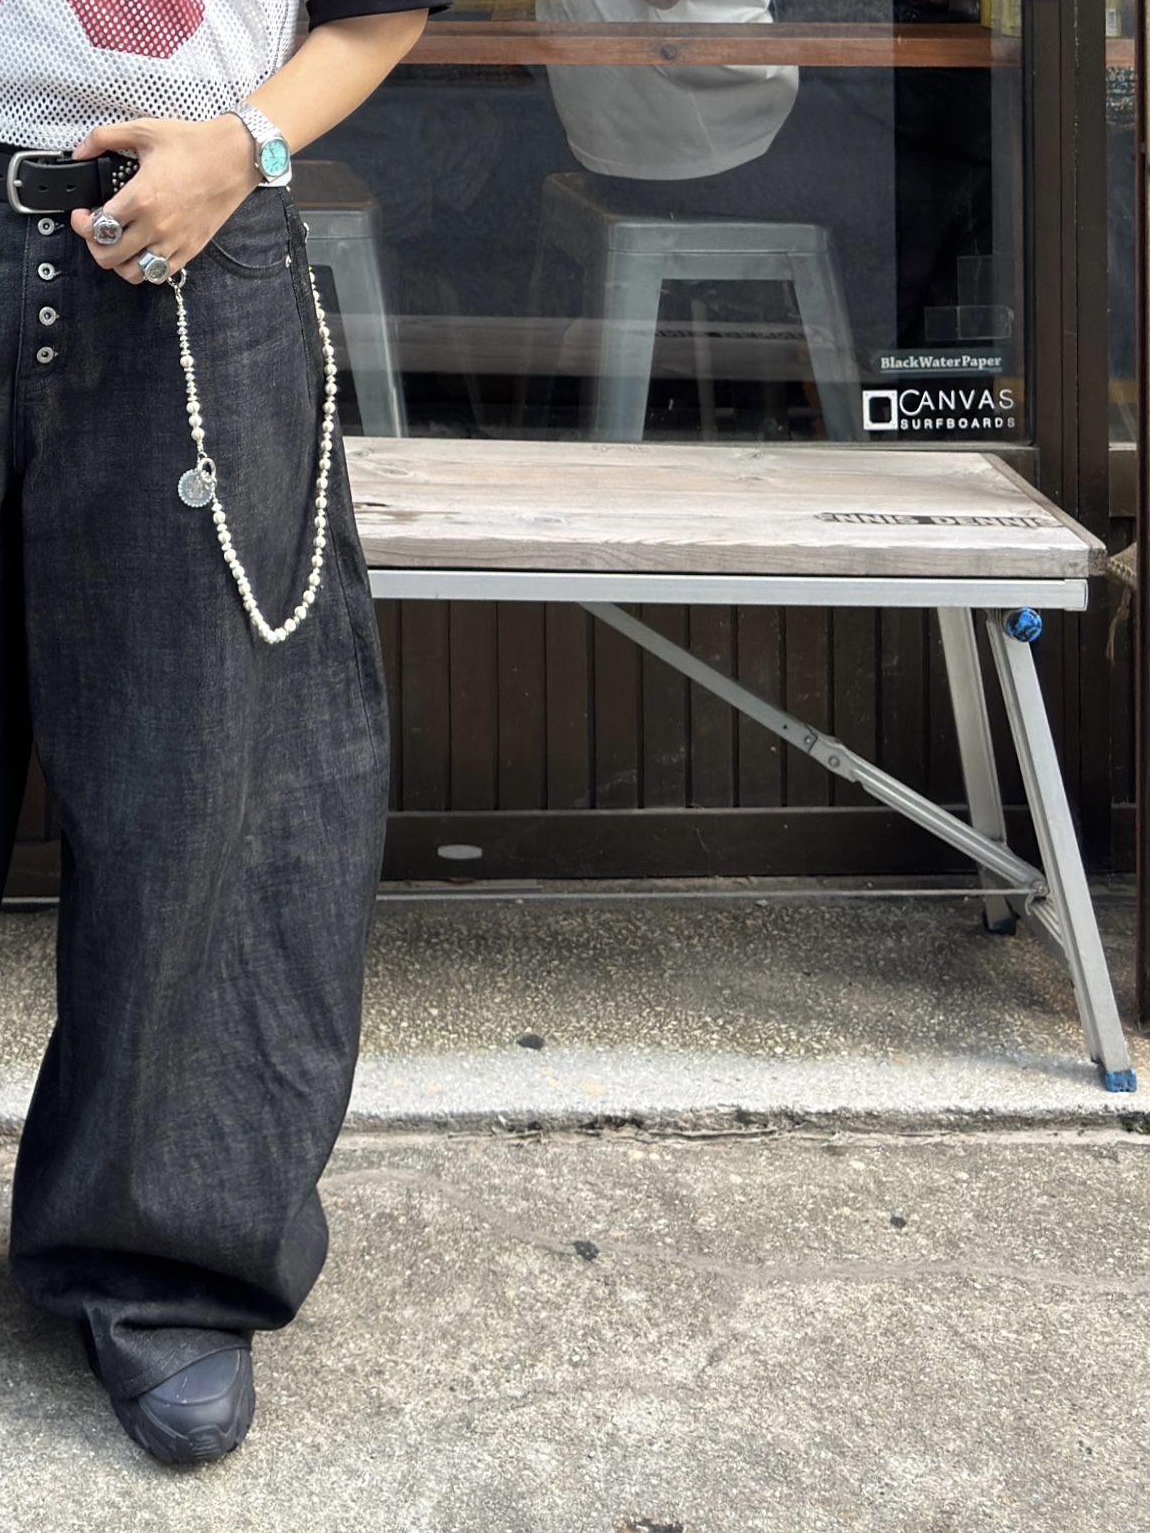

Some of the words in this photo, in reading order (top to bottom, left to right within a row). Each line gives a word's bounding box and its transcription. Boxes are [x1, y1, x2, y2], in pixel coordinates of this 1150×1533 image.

[880, 355, 1002, 371] BlackWaterPaper
[899, 388, 1015, 416] CANVAS
[900, 417, 1016, 430] SURFBOARDS
